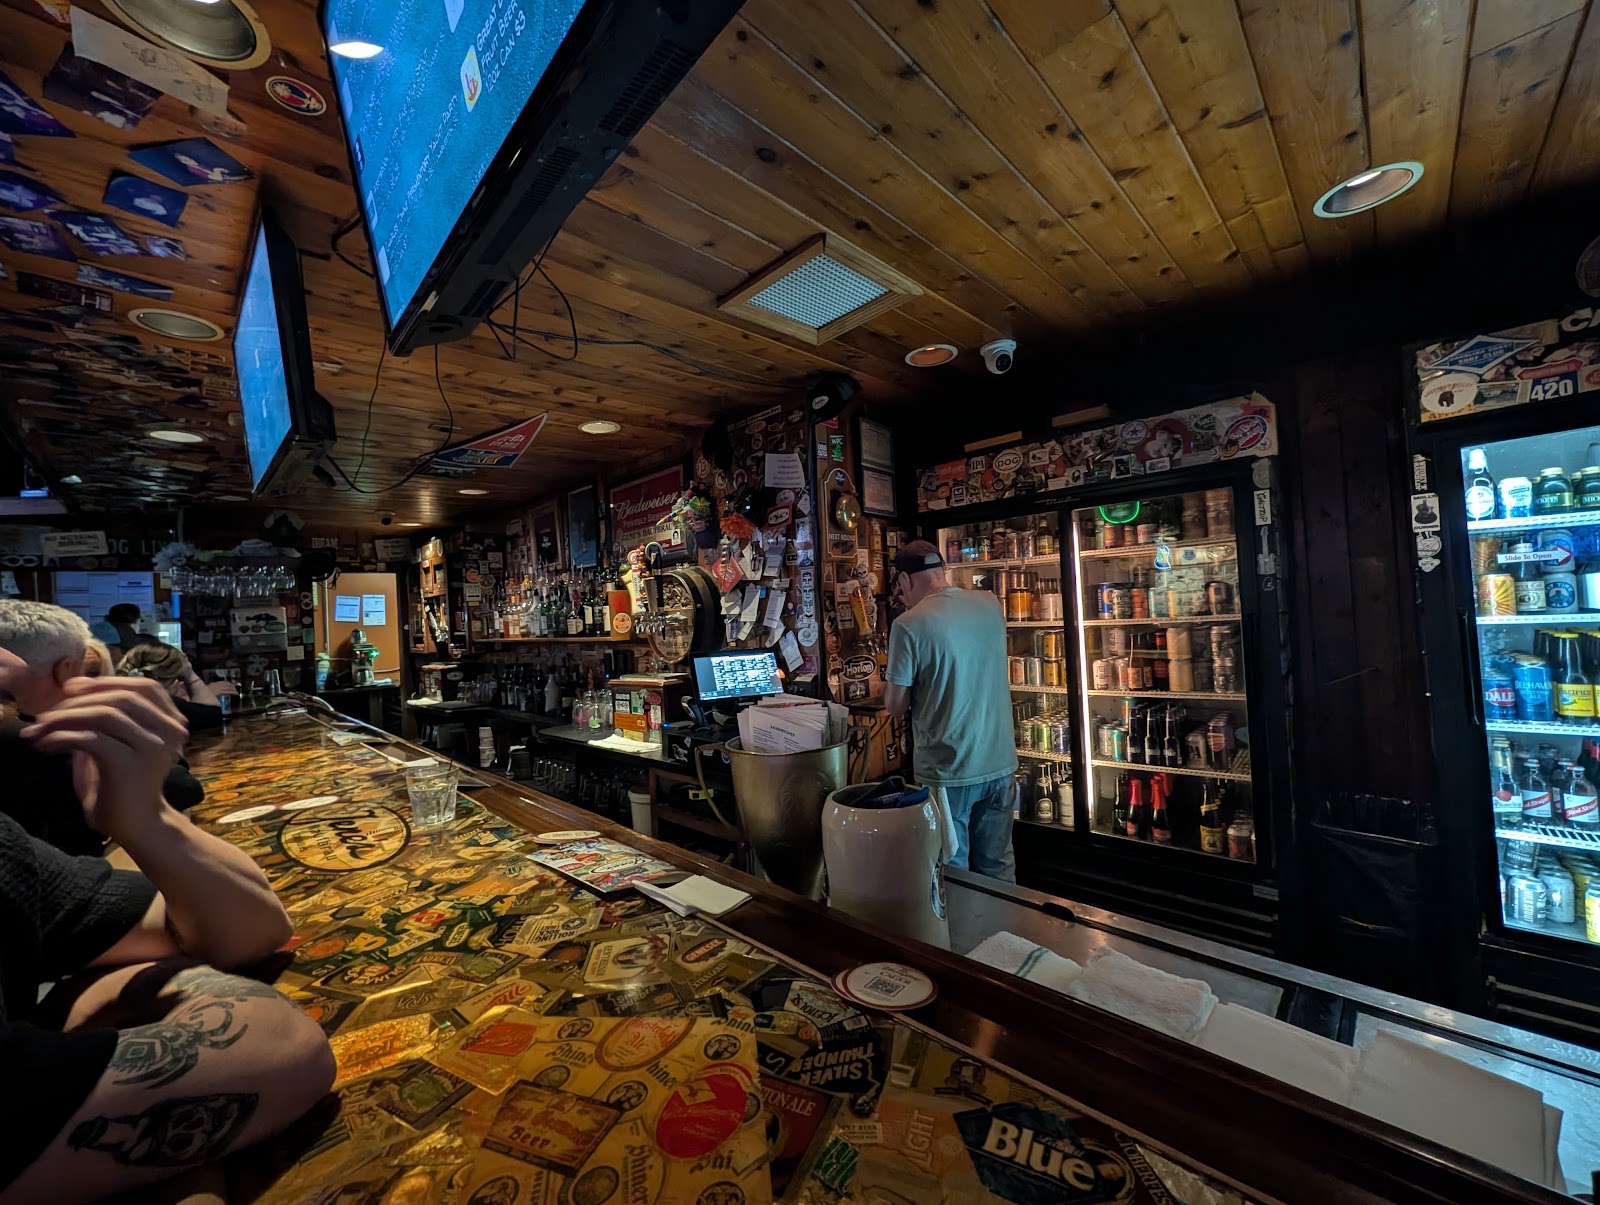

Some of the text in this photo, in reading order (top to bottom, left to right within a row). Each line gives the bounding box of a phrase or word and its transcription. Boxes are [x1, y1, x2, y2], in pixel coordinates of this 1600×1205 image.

[477, 5, 497, 52] GREAT
[480, 0, 518, 71] FRUIT BEER
[498, 34, 516, 67] CAN
[513, 9, 528, 37] $3
[1531, 378, 1574, 402] 420
[971, 459, 985, 471] IPA
[997, 456, 1019, 468] DOG
[615, 490, 679, 521] Budweiser
[1532, 553, 1552, 561] Open
[1557, 582, 1575, 594] TIRE
[846, 662, 872, 677] Horton
[1514, 680, 1552, 690] BELHAVEN
[534, 930, 575, 945] ROLLING
[686, 938, 725, 961] GENESEE
[792, 993, 841, 1022] ICEHOUSE
[792, 1042, 876, 1074] THUNDER
[645, 1060, 678, 1090] hiner
[799, 1060, 864, 1086] SILVER
[761, 1086, 817, 1118] TON ALE
[507, 1124, 552, 1149] Beer
[906, 1109, 936, 1168] LIGHT
[981, 1117, 1097, 1192] Blue
